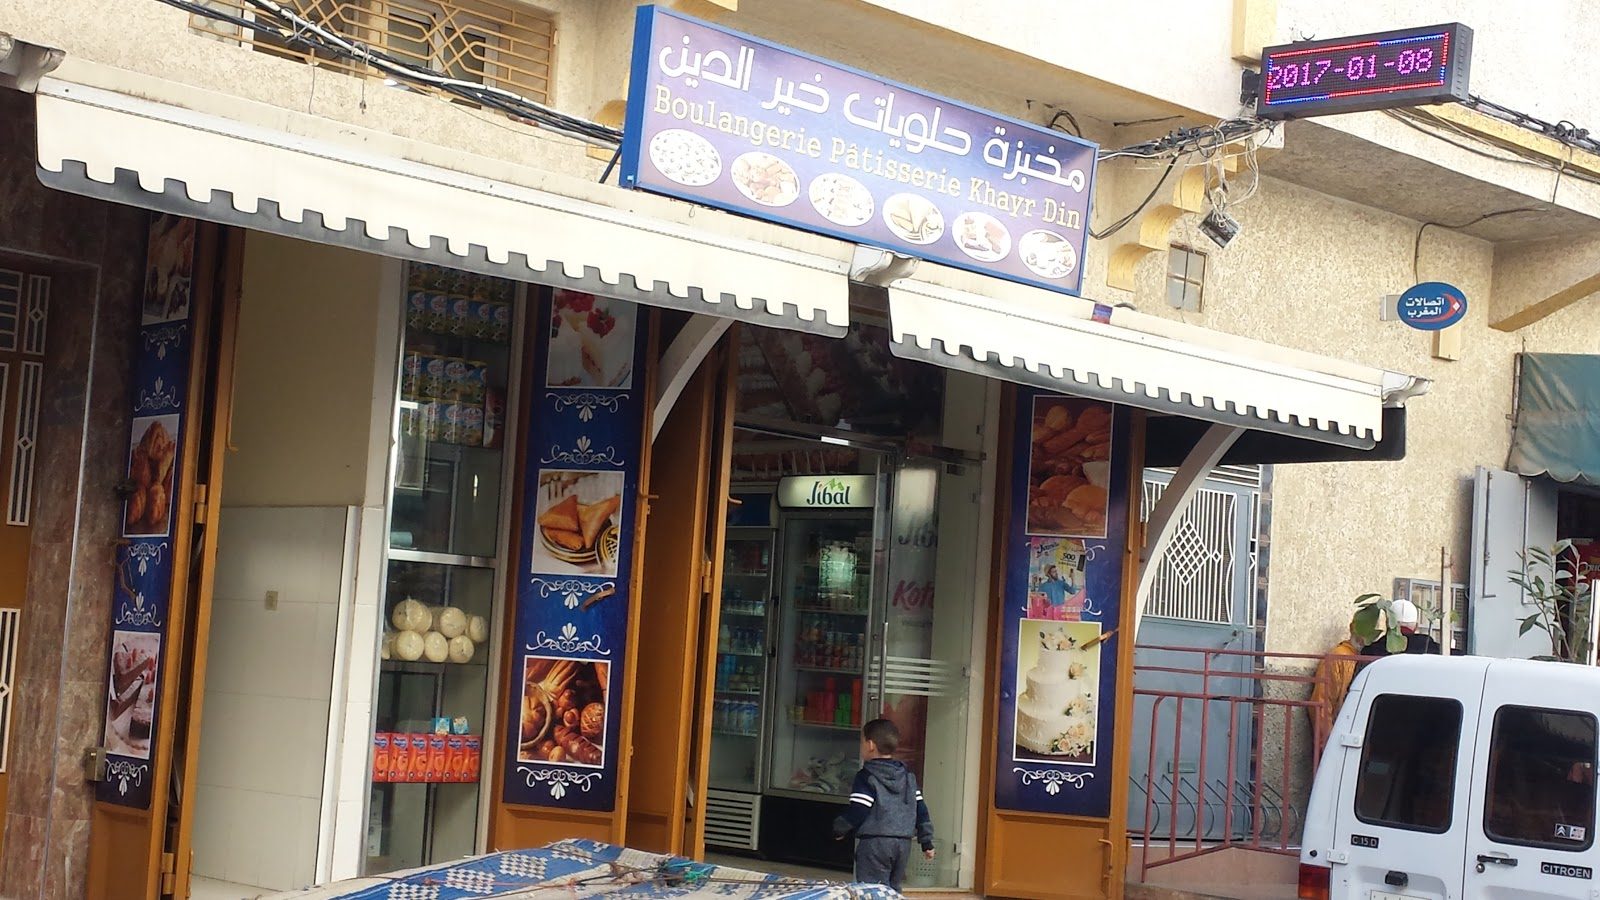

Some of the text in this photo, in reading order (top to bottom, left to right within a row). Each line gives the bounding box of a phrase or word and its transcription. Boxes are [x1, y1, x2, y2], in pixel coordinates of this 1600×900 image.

[658, 35, 1085, 192] مخبزة حلويات خير الدين
[653, 84, 1081, 230] Boulangerie Pâtisserie Khayr Din
[1405, 297, 1445, 307] اتصالات
[1407, 307, 1442, 318] المغرب
[806, 481, 851, 505] Jibal
[1352, 836, 1359, 844] C
[1370, 838, 1377, 847] D
[1542, 864, 1590, 879] CITROEN
